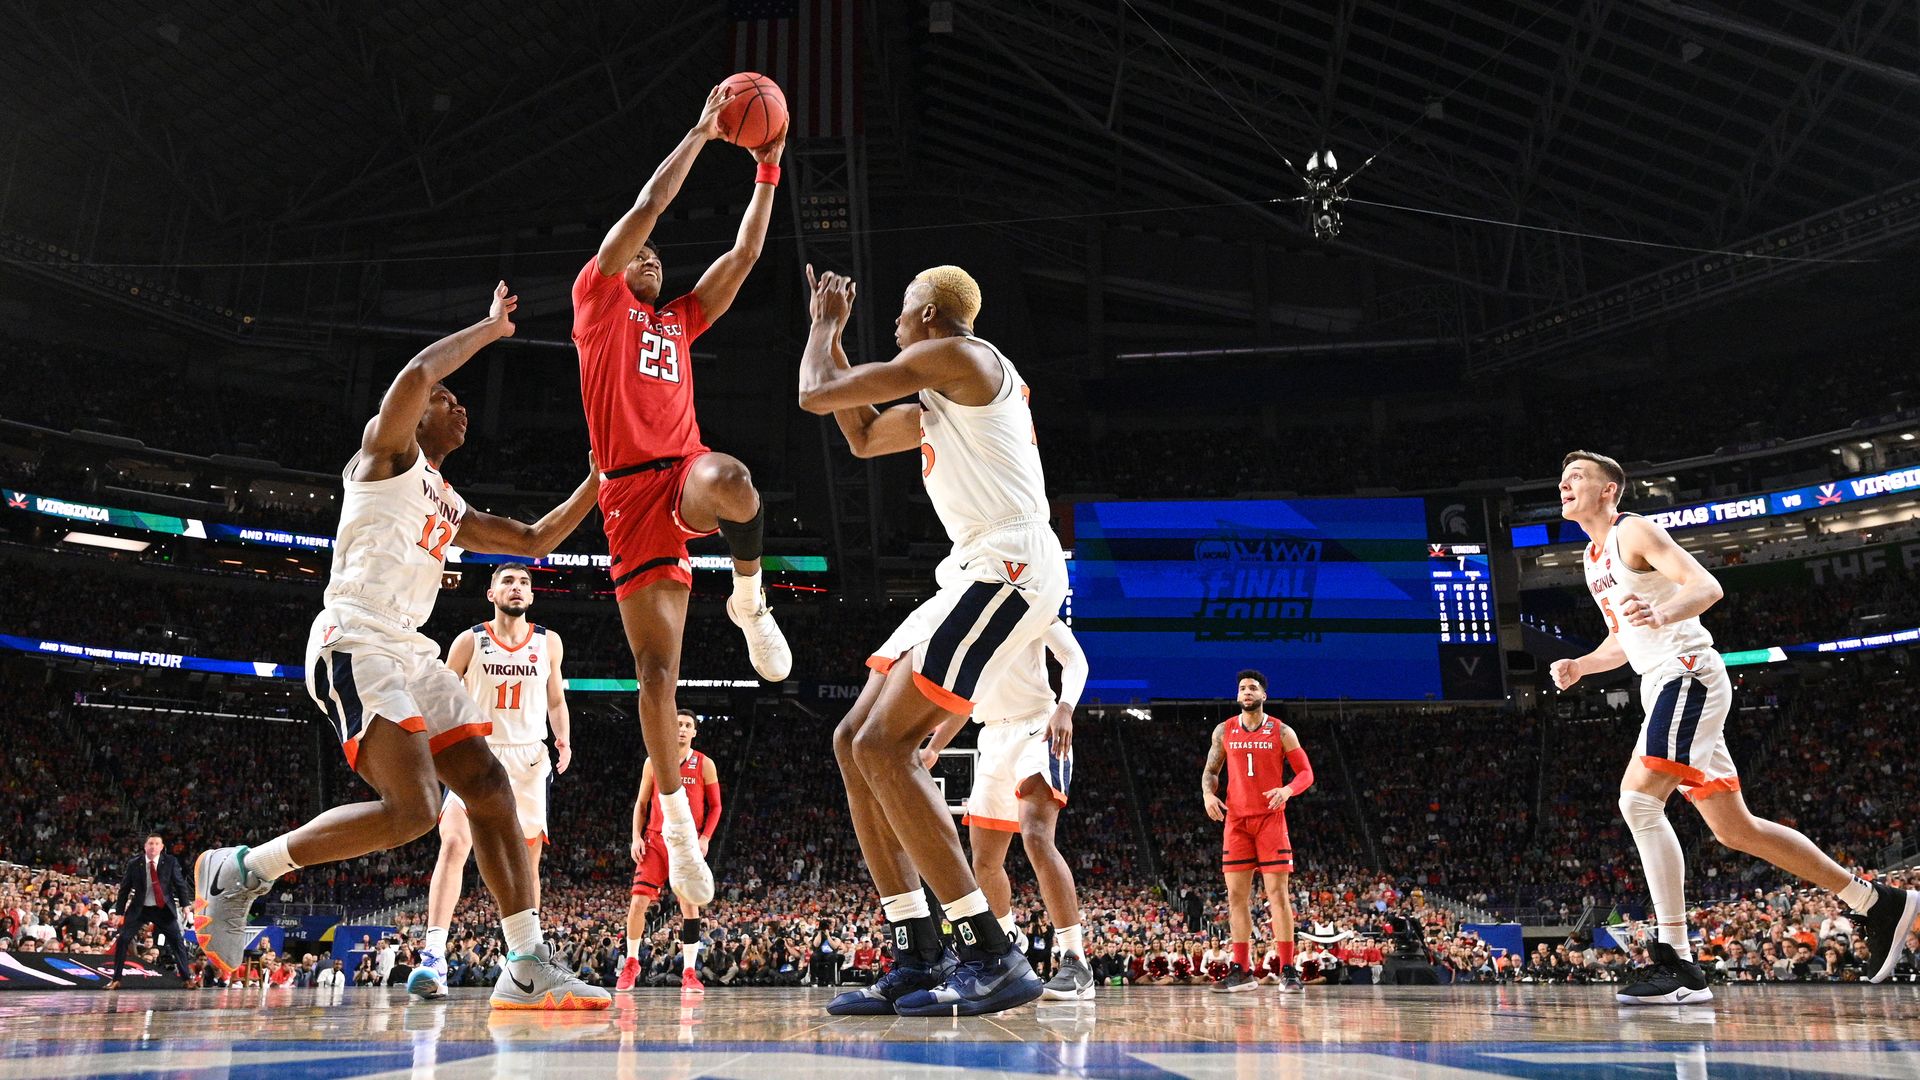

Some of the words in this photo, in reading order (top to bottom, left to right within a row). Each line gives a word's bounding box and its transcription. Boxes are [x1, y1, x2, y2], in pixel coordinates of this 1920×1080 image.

[638, 330, 680, 384] 23
[36, 497, 110, 522] VIRGINIA
[1711, 498, 1766, 520] TECH
[1781, 494, 1801, 508] VS
[239, 529, 263, 541] AND
[264, 532, 293, 544] THEN
[295, 535, 329, 548] THERE
[416, 512, 452, 563] 12
[547, 553, 590, 567] TEXAS
[591, 555, 612, 567] TEC
[688, 556, 734, 568] IRGINI
[1456, 556, 1465, 571] 7
[1590, 572, 1618, 595] RGINIA
[1600, 596, 1619, 633] 5
[39, 641, 59, 652] AND
[60, 643, 83, 655] THEN
[84, 647, 113, 658] THERE
[140, 651, 183, 668] FOUR
[1818, 642, 1837, 652] AND
[482, 663, 538, 676] VIRGINIA
[495, 680, 522, 709] 11
[818, 684, 861, 698] FINA
[1229, 741, 1252, 749] TEXAS
[1253, 741, 1273, 750] TECH
[1246, 752, 1255, 777] 1
